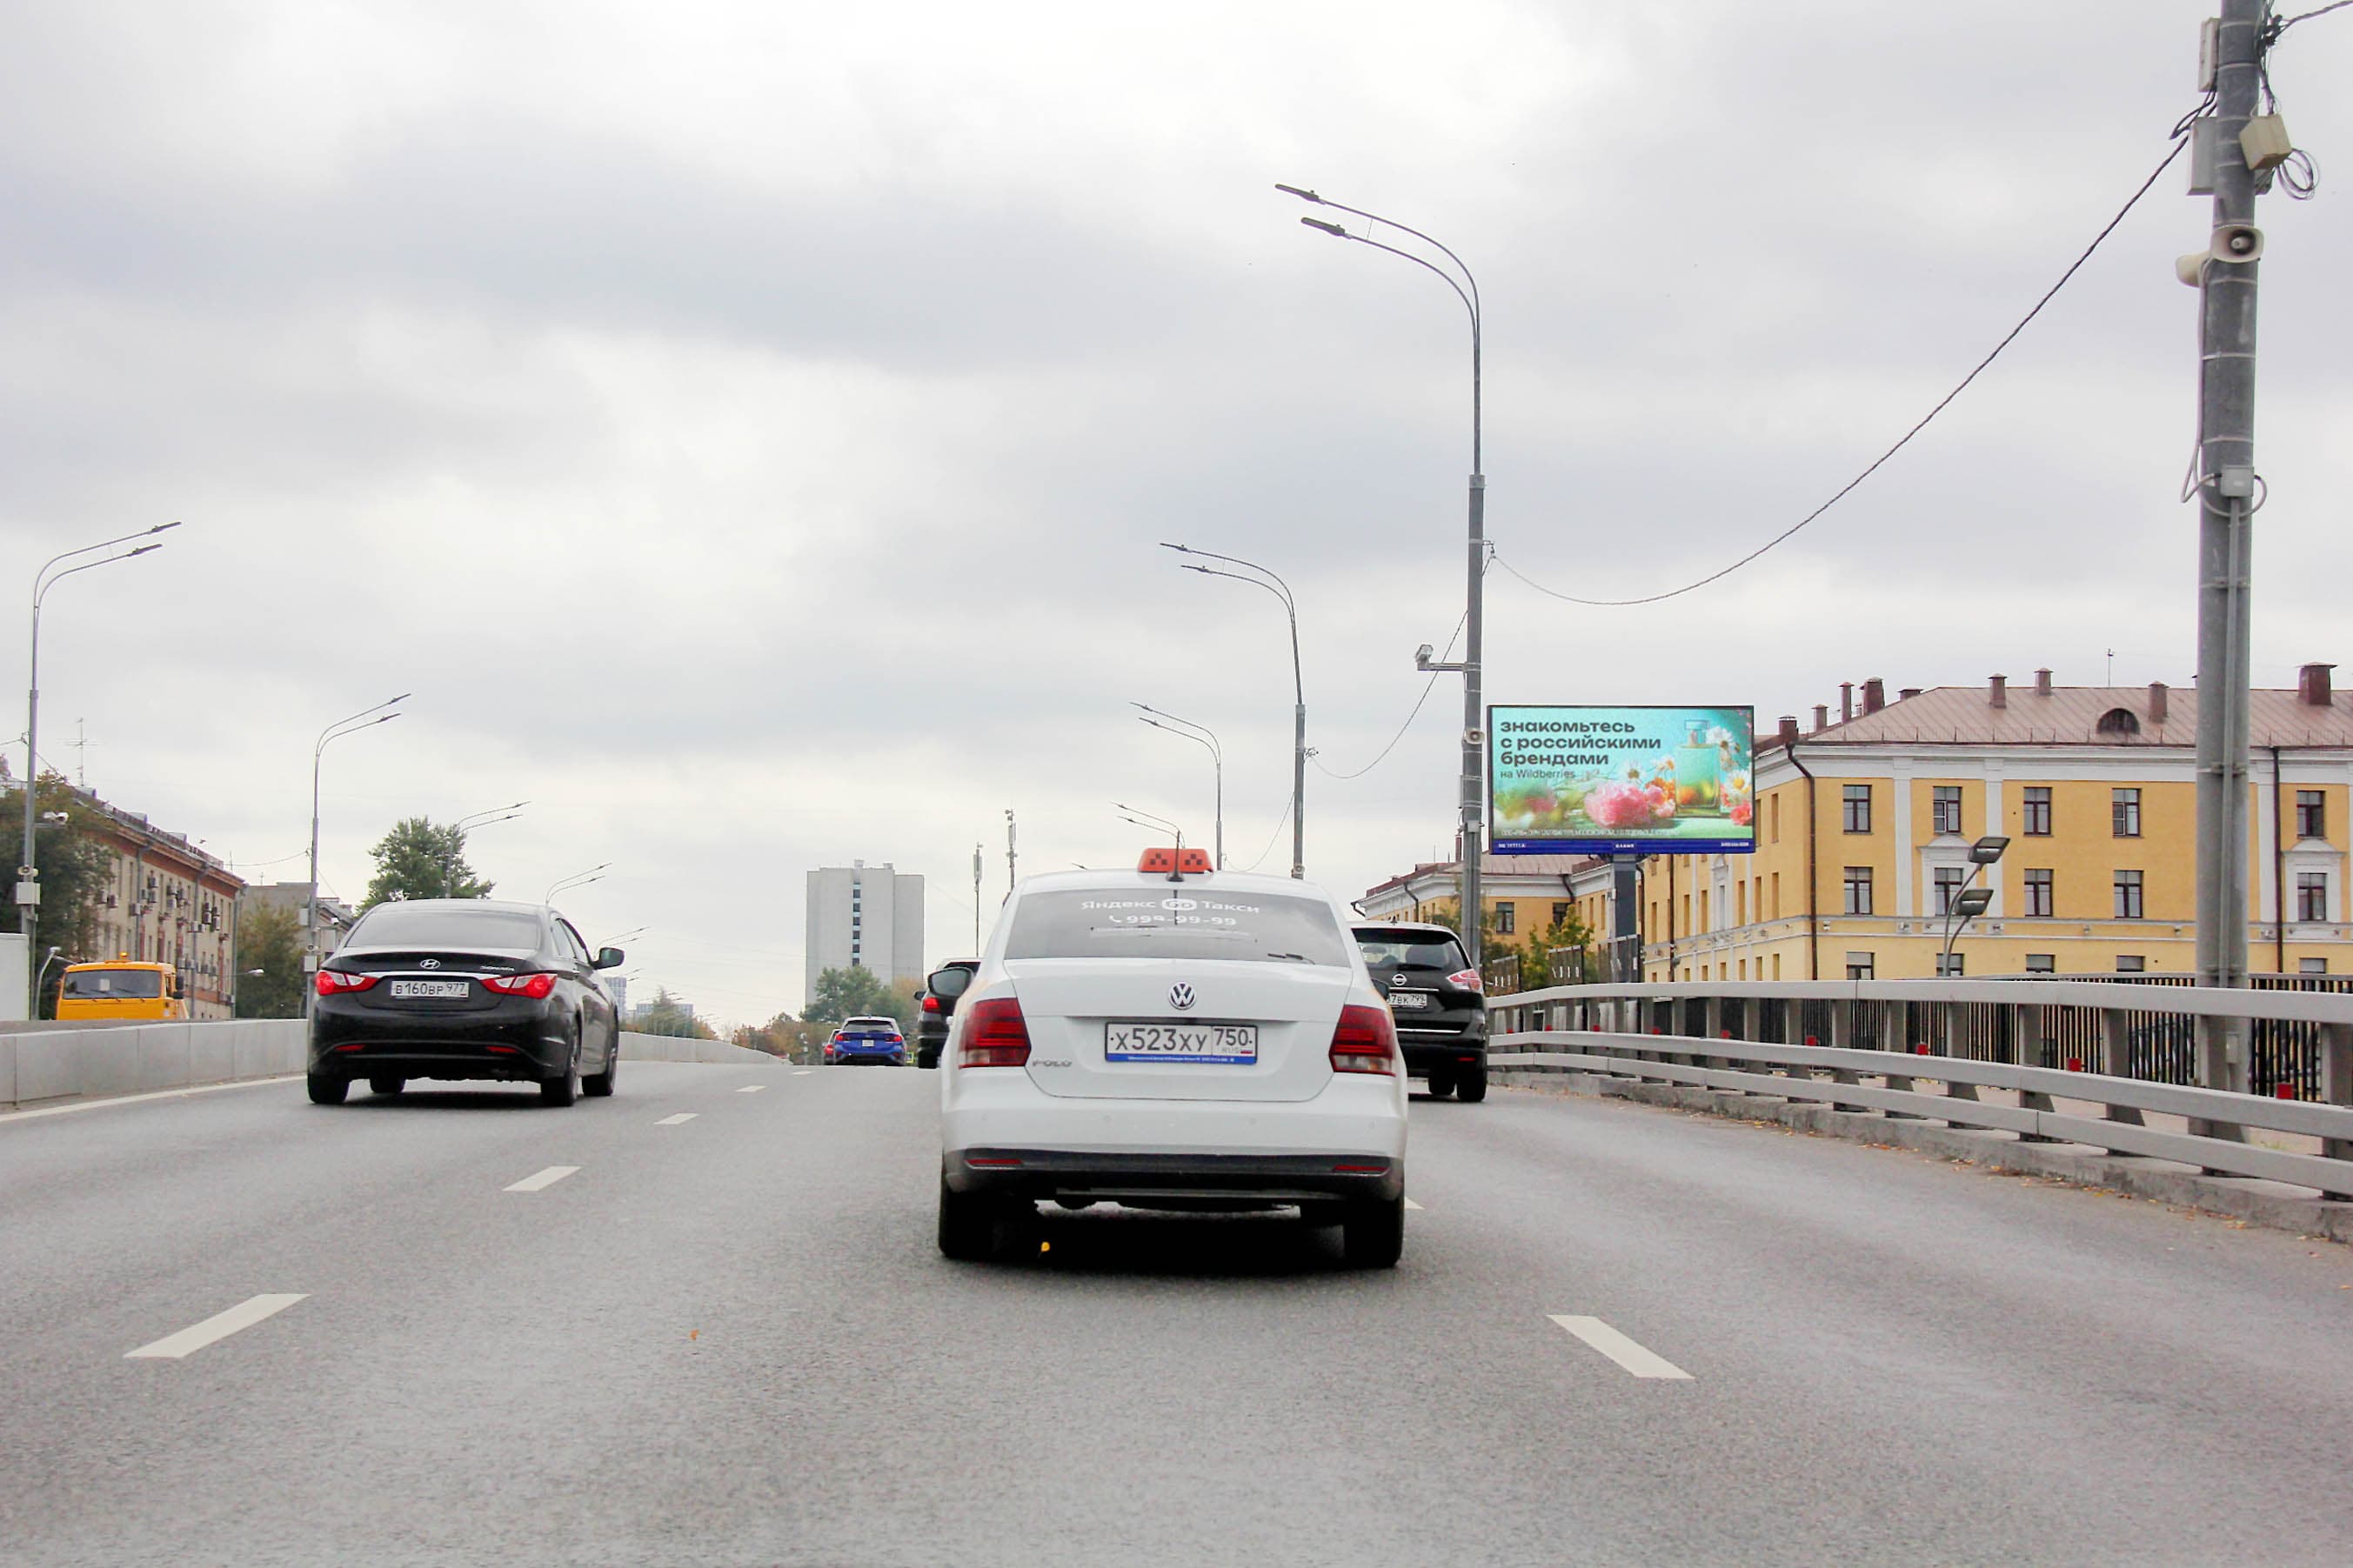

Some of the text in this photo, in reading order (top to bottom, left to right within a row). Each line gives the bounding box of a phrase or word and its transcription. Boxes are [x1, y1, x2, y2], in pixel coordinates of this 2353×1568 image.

[1500, 721, 1635, 733] знакомьтесь
[1500, 734, 1661, 751] с российскими
[1500, 751, 1609, 767] брендами
[1500, 769, 1576, 779] на Wildberries
[1081, 899, 1157, 911] Яндекс
[1200, 899, 1260, 913] Такси
[446, 983, 465, 993] 977
[1213, 1028, 1249, 1046] 750
